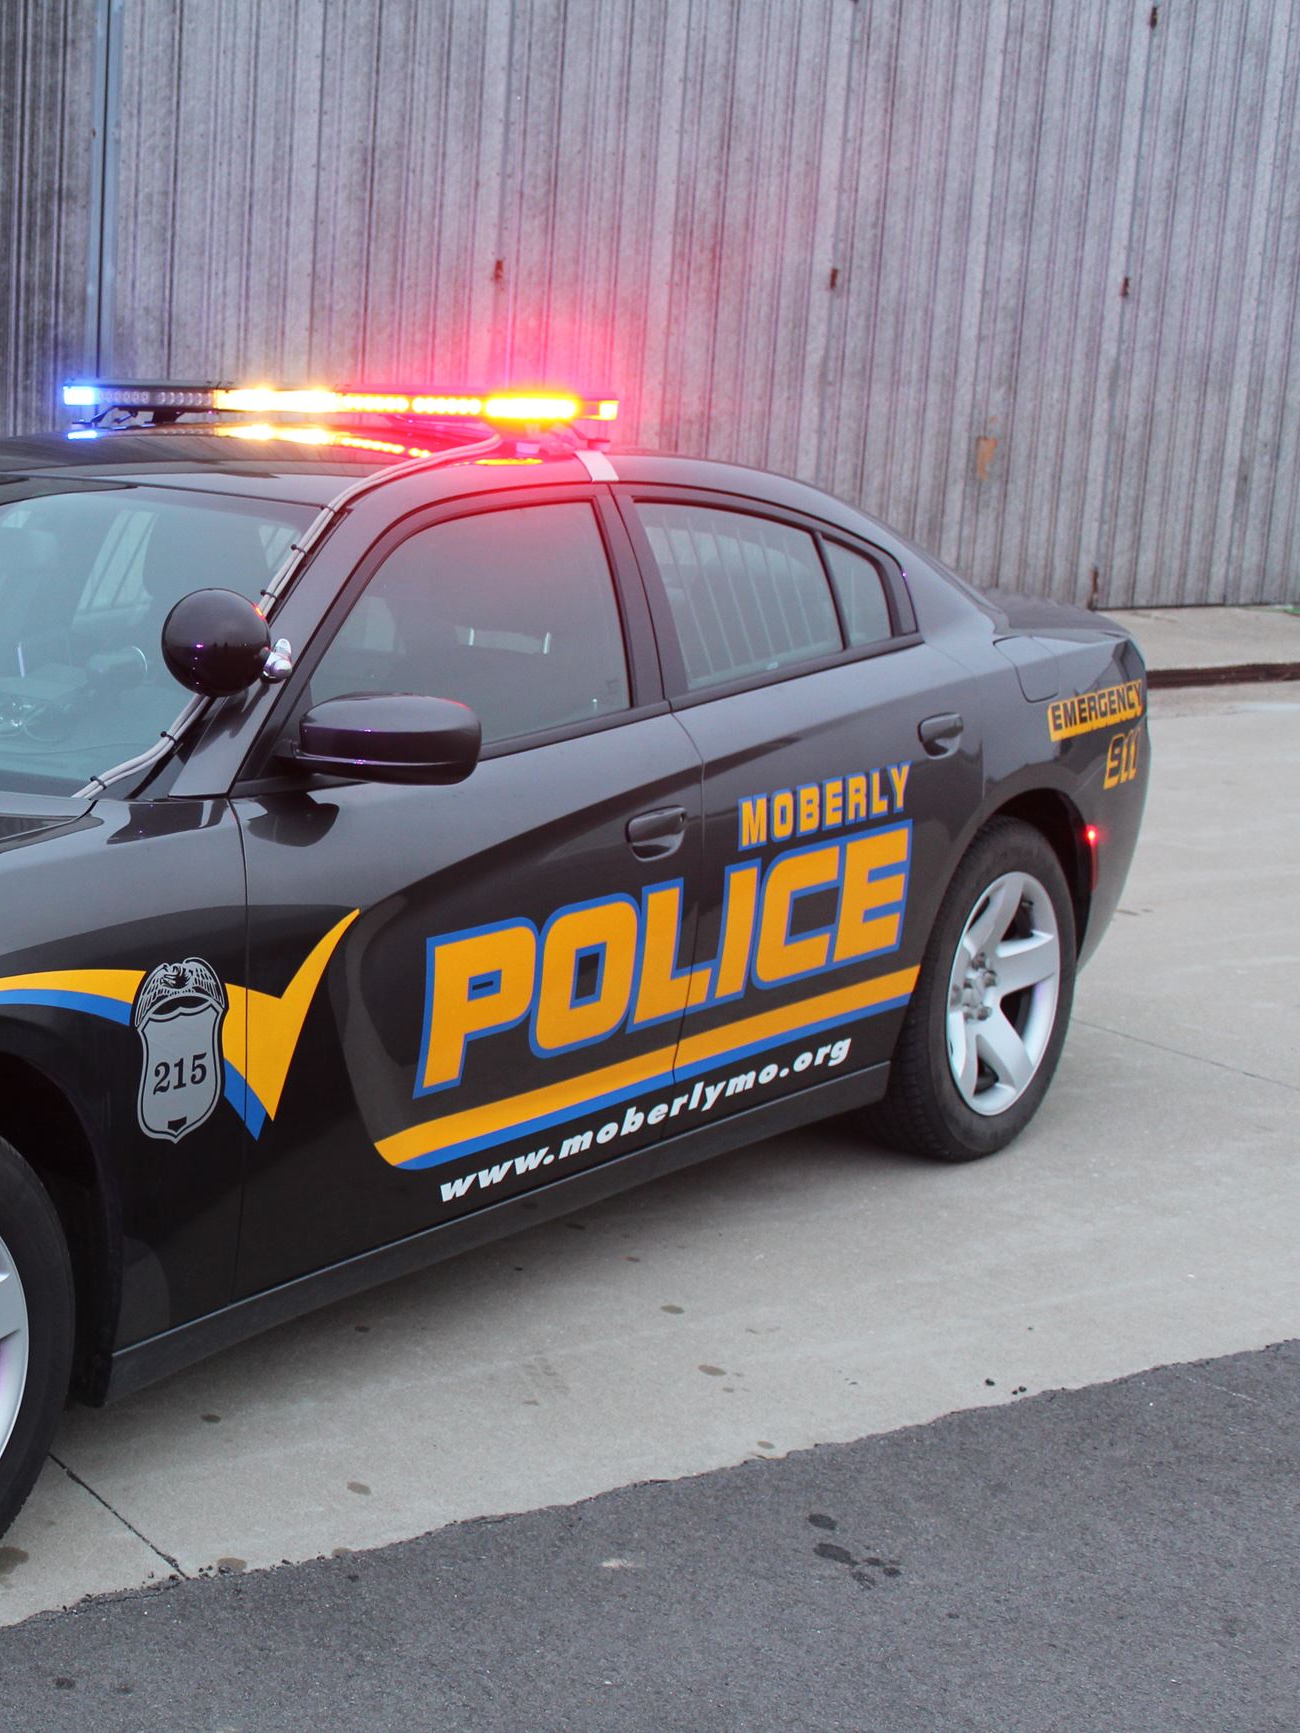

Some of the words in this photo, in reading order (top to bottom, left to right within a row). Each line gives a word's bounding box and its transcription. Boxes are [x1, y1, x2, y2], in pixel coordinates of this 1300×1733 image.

[1049, 680, 1143, 740] EMERGENCY
[1104, 727, 1141, 789] 911
[739, 761, 912, 851] MOBERLY
[413, 820, 913, 1100] POLICE
[153, 1052, 207, 1095] 215
[439, 1037, 853, 1203] www.moberlymo.org
